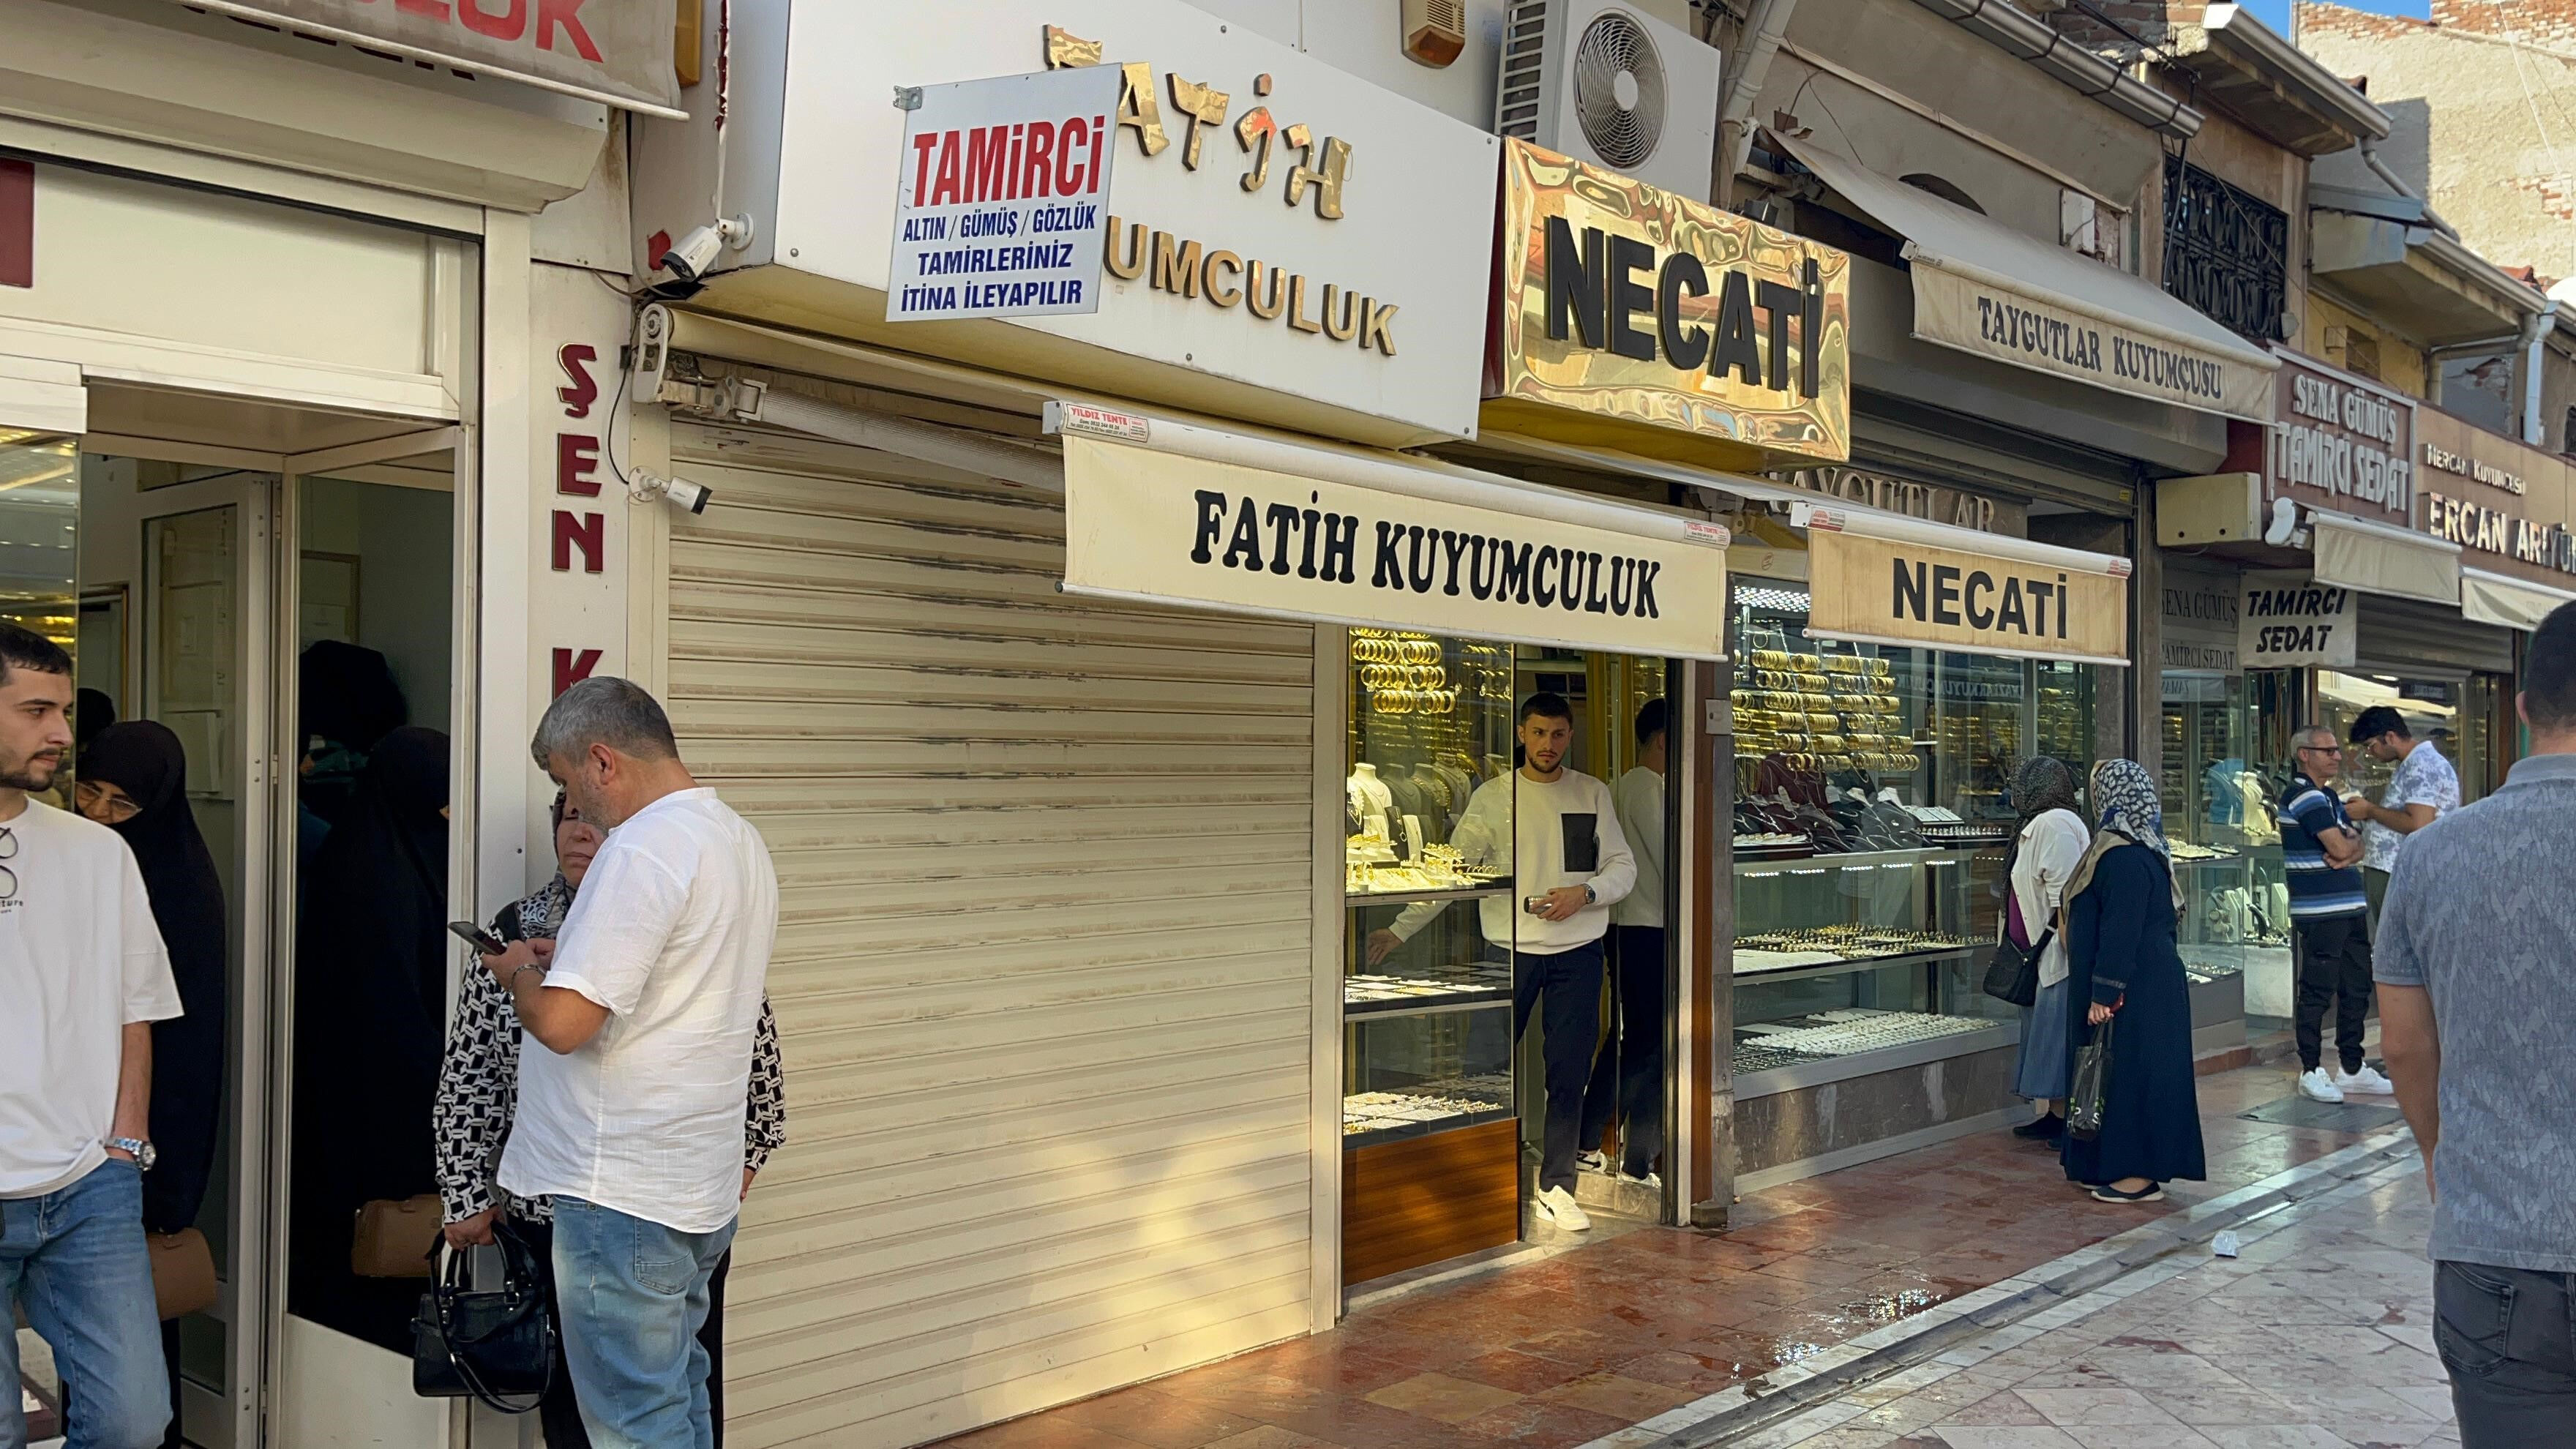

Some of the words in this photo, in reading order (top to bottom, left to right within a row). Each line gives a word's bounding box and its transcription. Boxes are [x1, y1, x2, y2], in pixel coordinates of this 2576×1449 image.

[902, 217, 947, 242] ALTIN
[960, 207, 1018, 239] GÜMÜŞ
[1033, 201, 1097, 233] GÖZLÜK
[918, 239, 1074, 277] TAMİRLERİNİZ
[901, 281, 957, 312] İTİNA
[1102, 215, 1400, 356] UMCULUK
[1543, 214, 1821, 399] NECATİ
[1977, 296, 2102, 372] TAYGUTLAR
[2113, 336, 2222, 399] KUYUMCUSU
[2292, 374, 2340, 425] SENA
[2343, 387, 2397, 453] GÜMÜŞ
[2277, 420, 2351, 498] TAMİRCİ
[2353, 445, 2409, 513] SEDAT
[1190, 489, 1360, 585] FATİH
[1371, 520, 1661, 620] KUYUMCULUK
[2429, 491, 2508, 555] ERCAN
[1892, 557, 2067, 640] NECATİ
[2255, 625, 2333, 653] SEDAT
